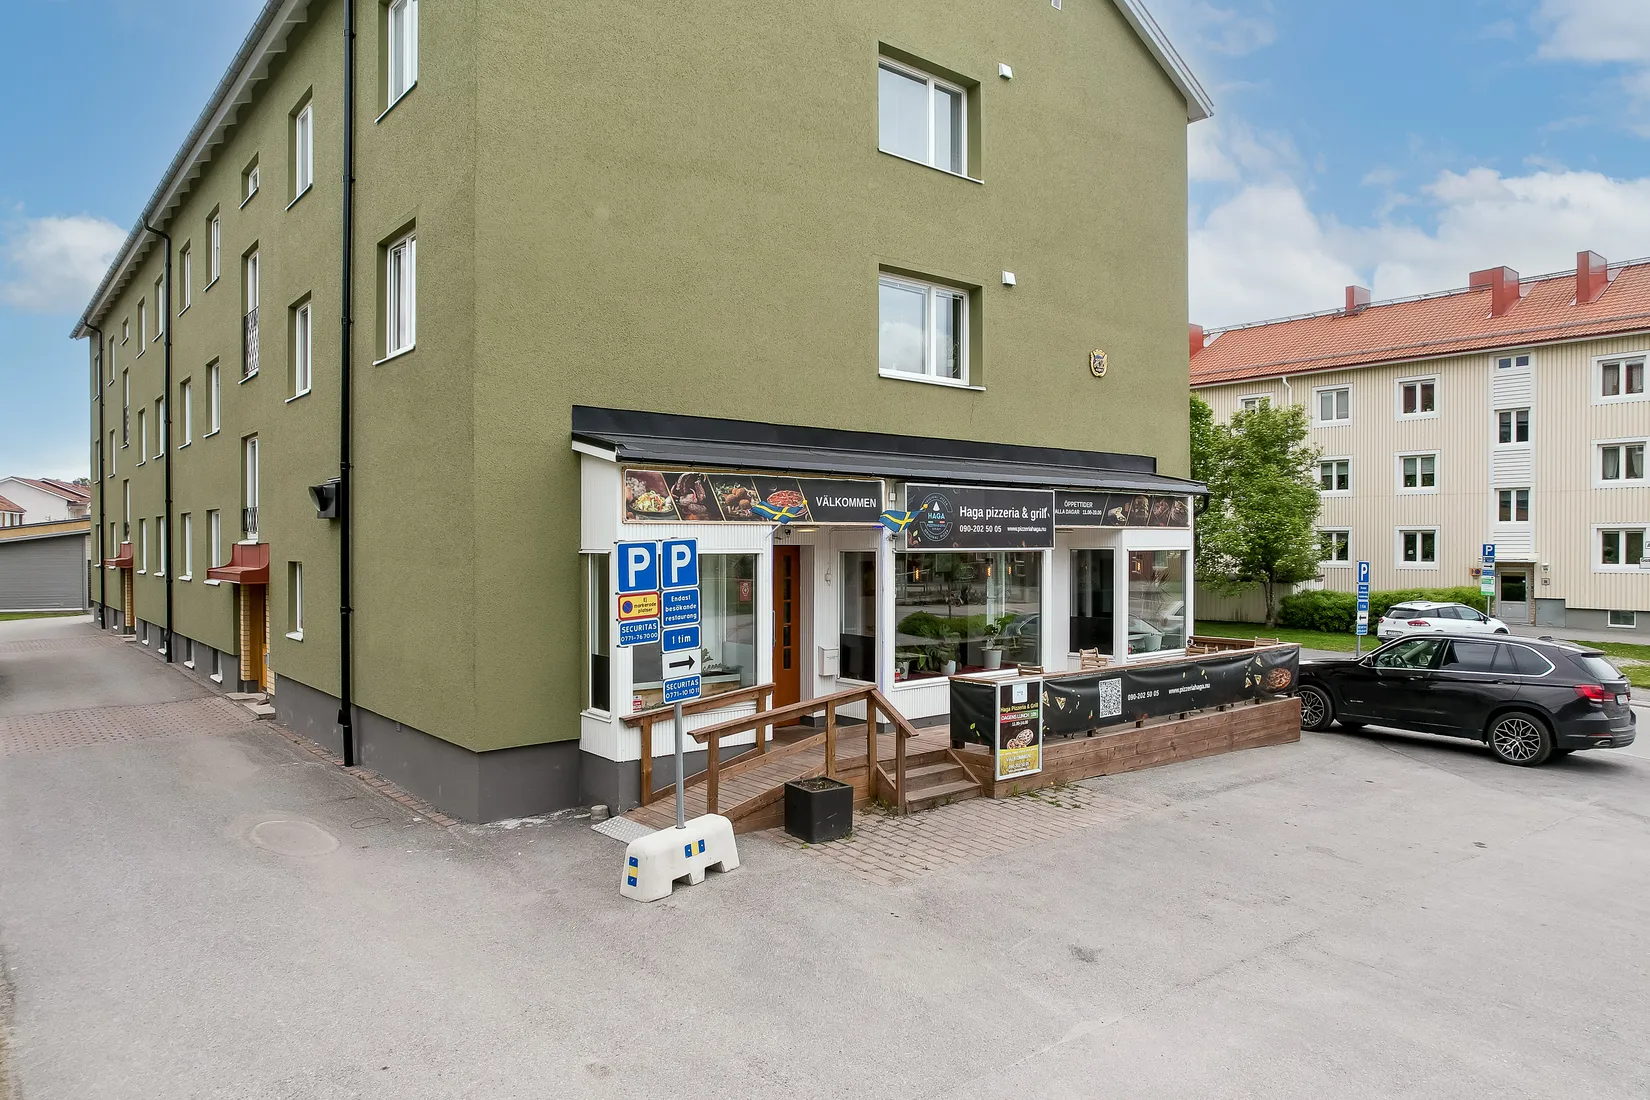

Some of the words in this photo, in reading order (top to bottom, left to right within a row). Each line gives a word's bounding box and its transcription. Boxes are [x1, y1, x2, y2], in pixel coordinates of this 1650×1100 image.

[816, 496, 877, 508] VÄLKOMMEN
[959, 506, 983, 520] Haga
[986, 507, 1020, 520] pizzeria
[1022, 507, 1028, 518] &
[1031, 507, 1048, 521] grill
[1486, 546, 1493, 555] P
[628, 547, 651, 588] P
[672, 544, 691, 584] P
[1361, 563, 1368, 581] P
[665, 604, 697, 612] besökande
[665, 613, 697, 622] restaurang
[622, 623, 657, 633] SECURITAS
[672, 636, 675, 644] 1
[678, 634, 691, 644] tim
[666, 679, 699, 691] SECURITAS
[1168, 683, 1210, 694] www.pizzeriahaga.nu
[666, 690, 688, 699] 0771-10
[1127, 692, 1146, 701] 090-202
